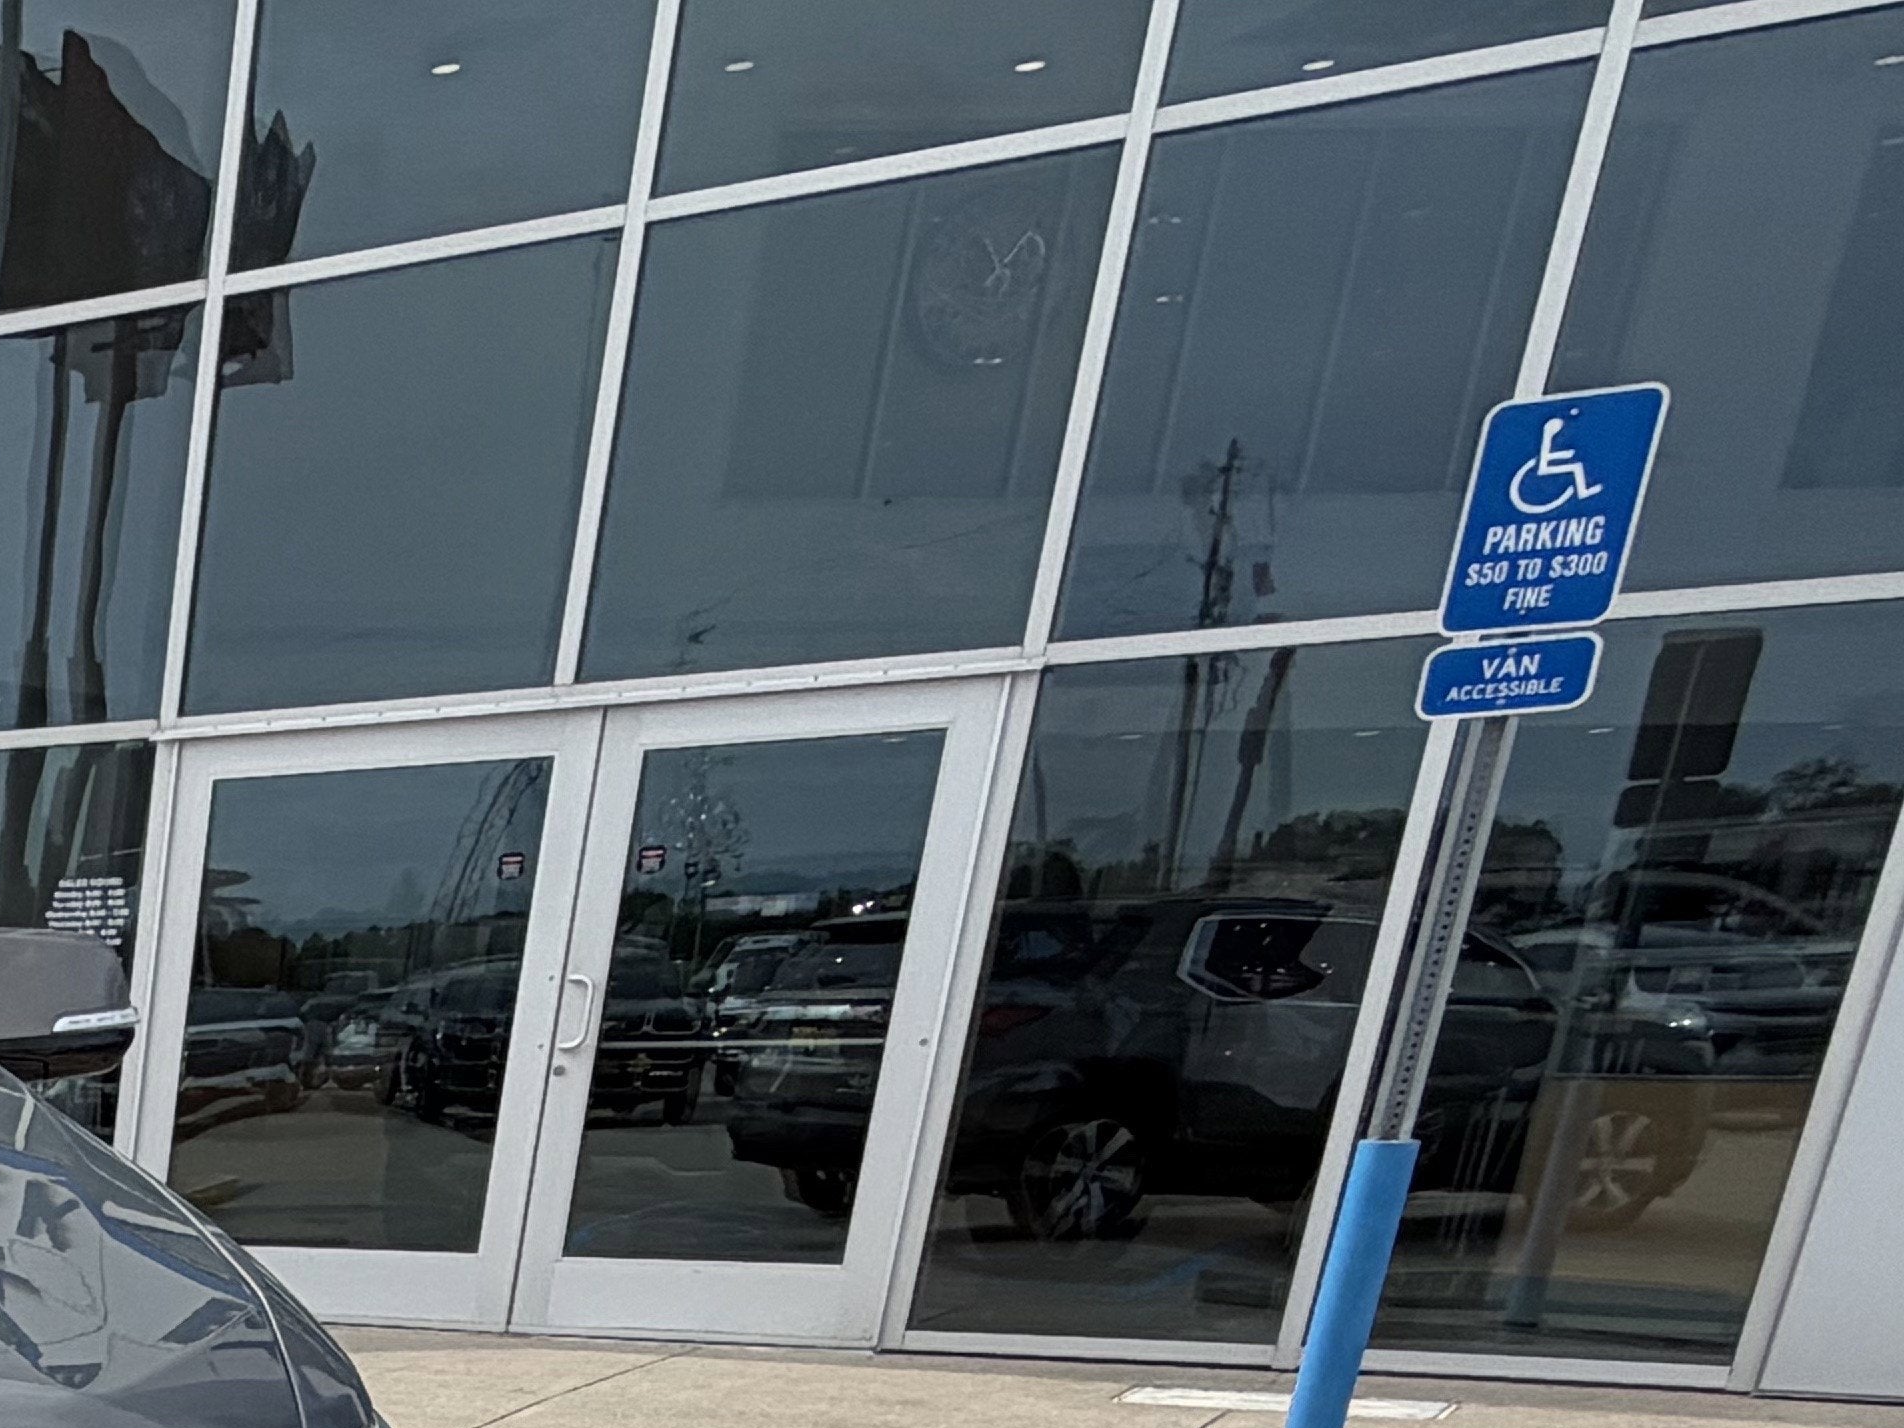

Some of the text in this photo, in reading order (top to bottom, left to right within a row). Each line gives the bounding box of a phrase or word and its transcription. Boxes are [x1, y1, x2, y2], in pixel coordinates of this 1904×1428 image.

[1483, 515, 1606, 556] PARKING
[1465, 551, 1609, 586] $50 TO $300
[1502, 584, 1554, 611] FINE
[1482, 653, 1541, 680] VAN
[1445, 676, 1564, 701] ACCESSIBLE
